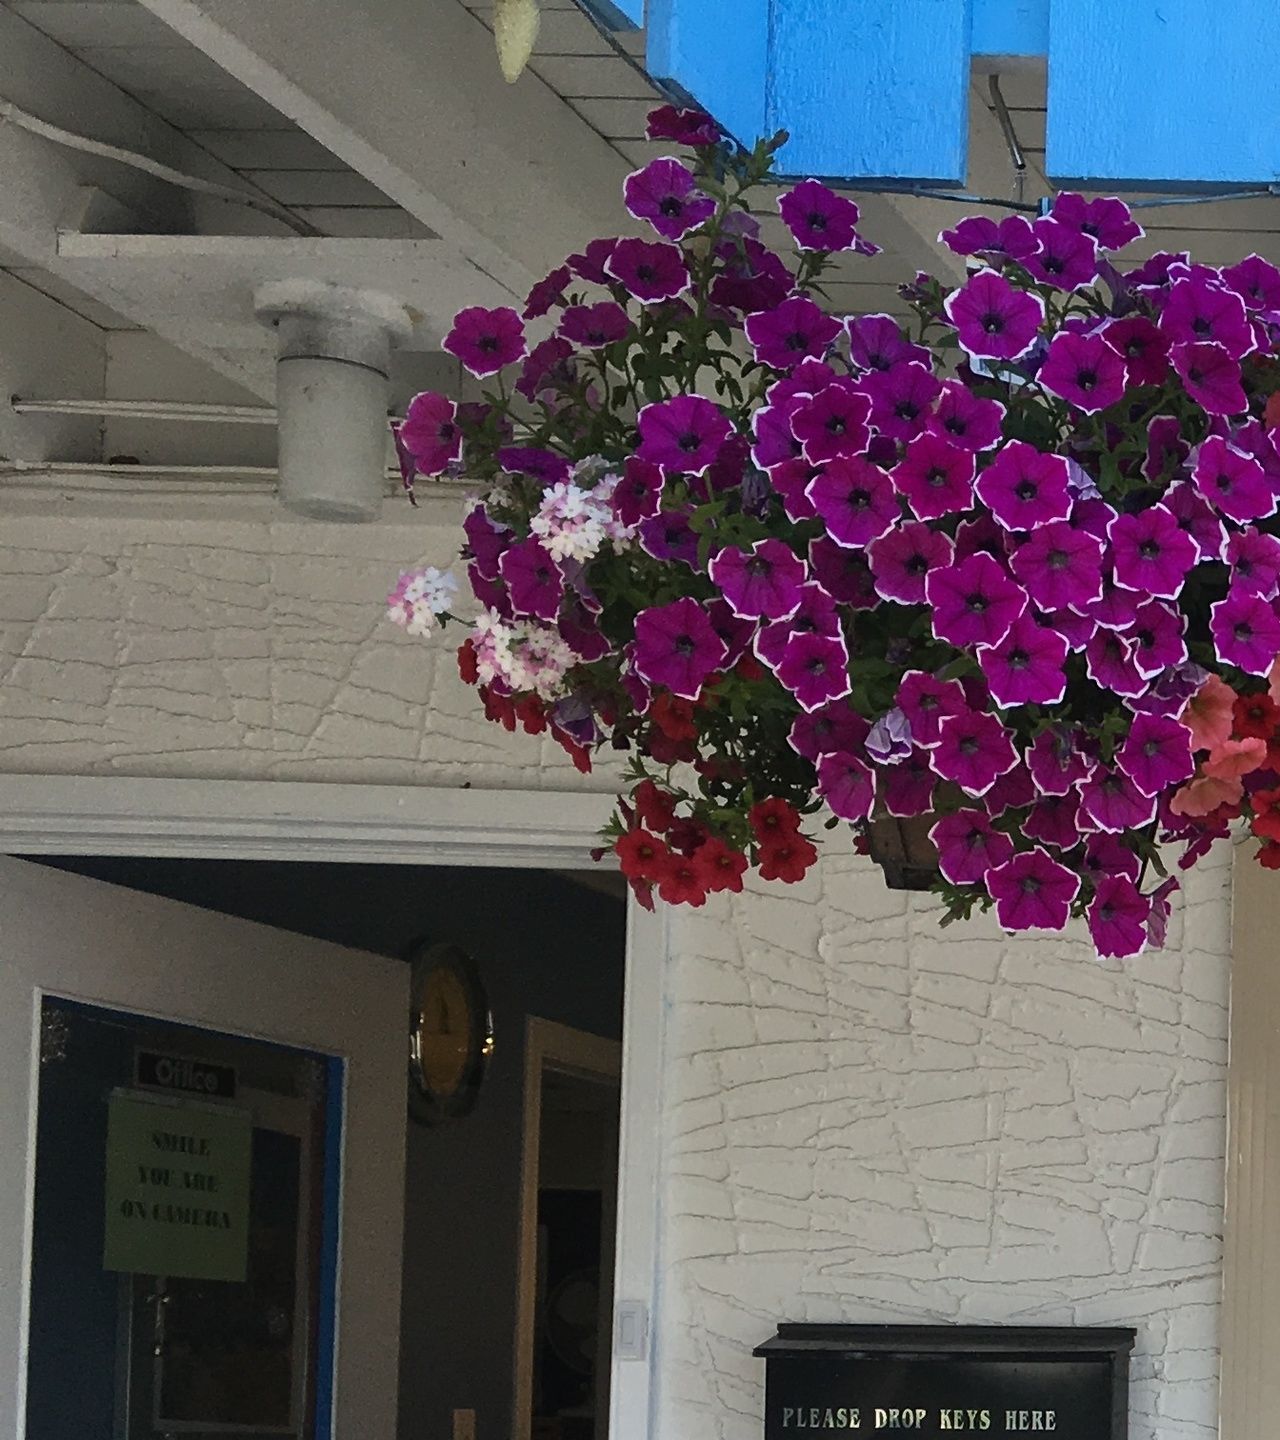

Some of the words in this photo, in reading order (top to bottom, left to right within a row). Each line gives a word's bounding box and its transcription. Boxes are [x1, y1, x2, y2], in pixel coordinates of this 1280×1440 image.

[152, 1132, 210, 1156] SMILE
[138, 1166, 175, 1187] YOU
[179, 1171, 218, 1192] ARE
[120, 1199, 148, 1219] ON
[152, 1202, 232, 1229] CAMERA
[782, 1408, 861, 1428] PLEASE
[874, 1408, 927, 1429] DROP
[940, 1409, 991, 1430] KEYS
[1005, 1410, 1057, 1431] HERE
